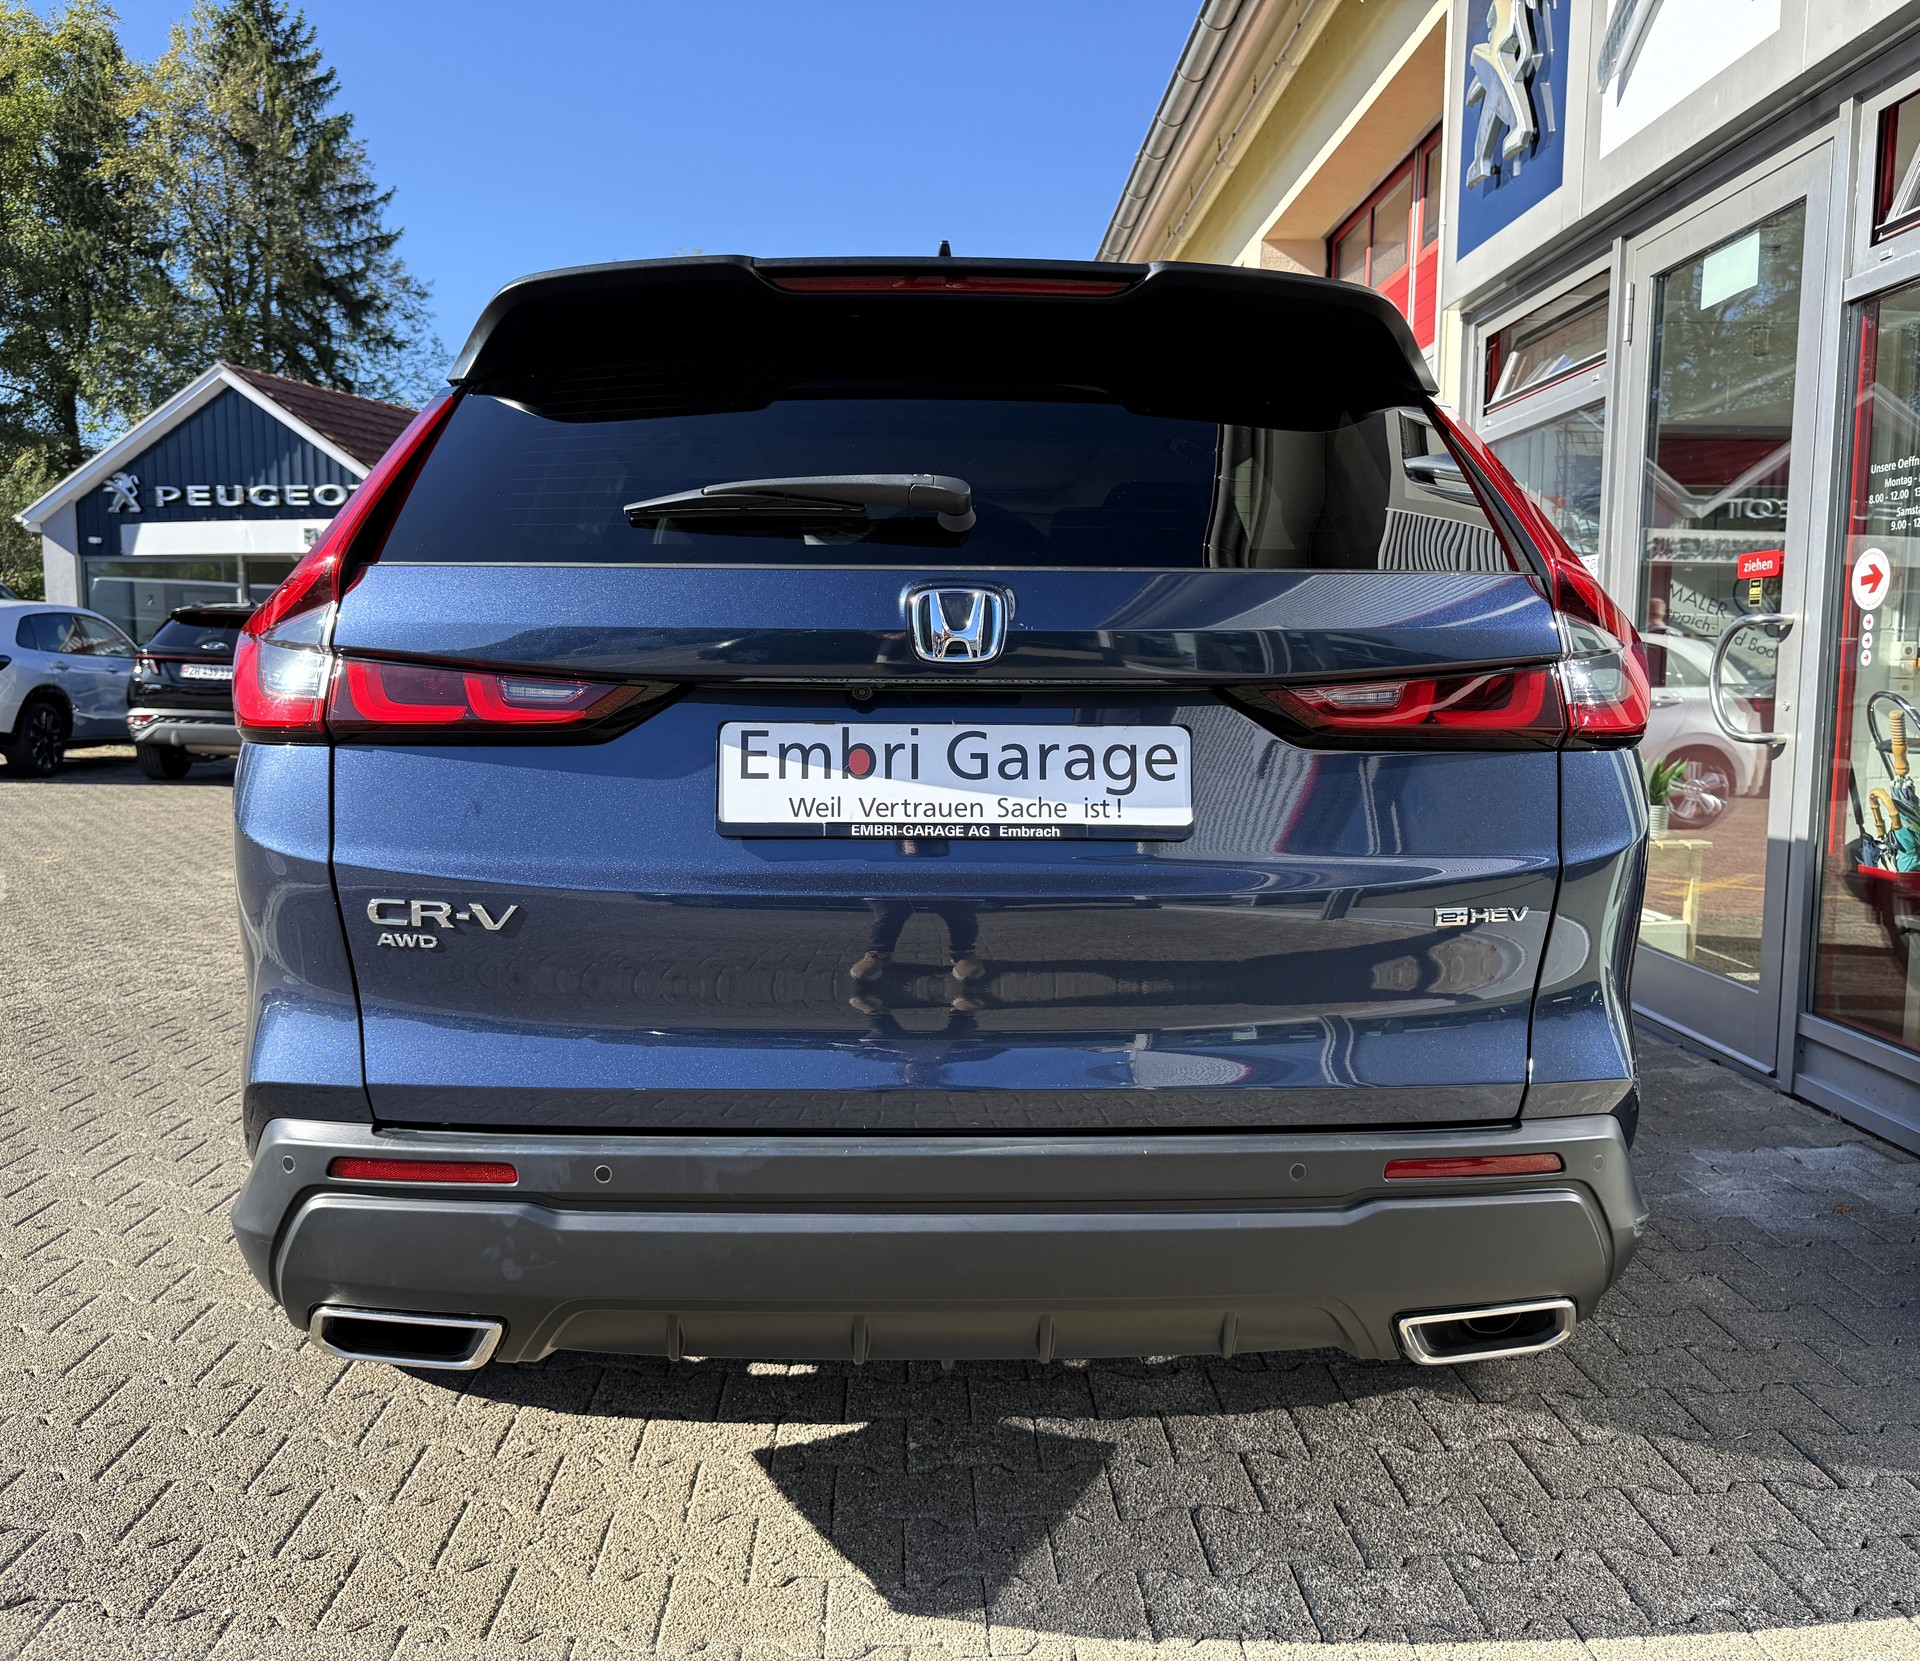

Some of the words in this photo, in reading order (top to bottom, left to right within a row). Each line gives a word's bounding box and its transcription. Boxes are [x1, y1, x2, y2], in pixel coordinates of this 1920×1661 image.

[1871, 462, 1896, 474] Unsere
[1884, 475, 1913, 488] Montag
[1868, 493, 1884, 504] 8.00
[1890, 489, 1909, 501] 12.00
[1890, 520, 1907, 531] 9.00
[1743, 557, 1773, 573] ziehen
[1668, 608, 1716, 632] eppich-
[740, 726, 919, 780] Embri
[946, 730, 1178, 796] Garage
[789, 796, 842, 818] Weil
[858, 797, 984, 818] Vertrauen
[997, 796, 1068, 818] Sache
[851, 824, 965, 837] EMBRI-GARAGE
[968, 825, 990, 837] AG
[999, 825, 1061, 838] Embrach
[367, 898, 519, 931] CR-V
[377, 932, 439, 949] AWD
